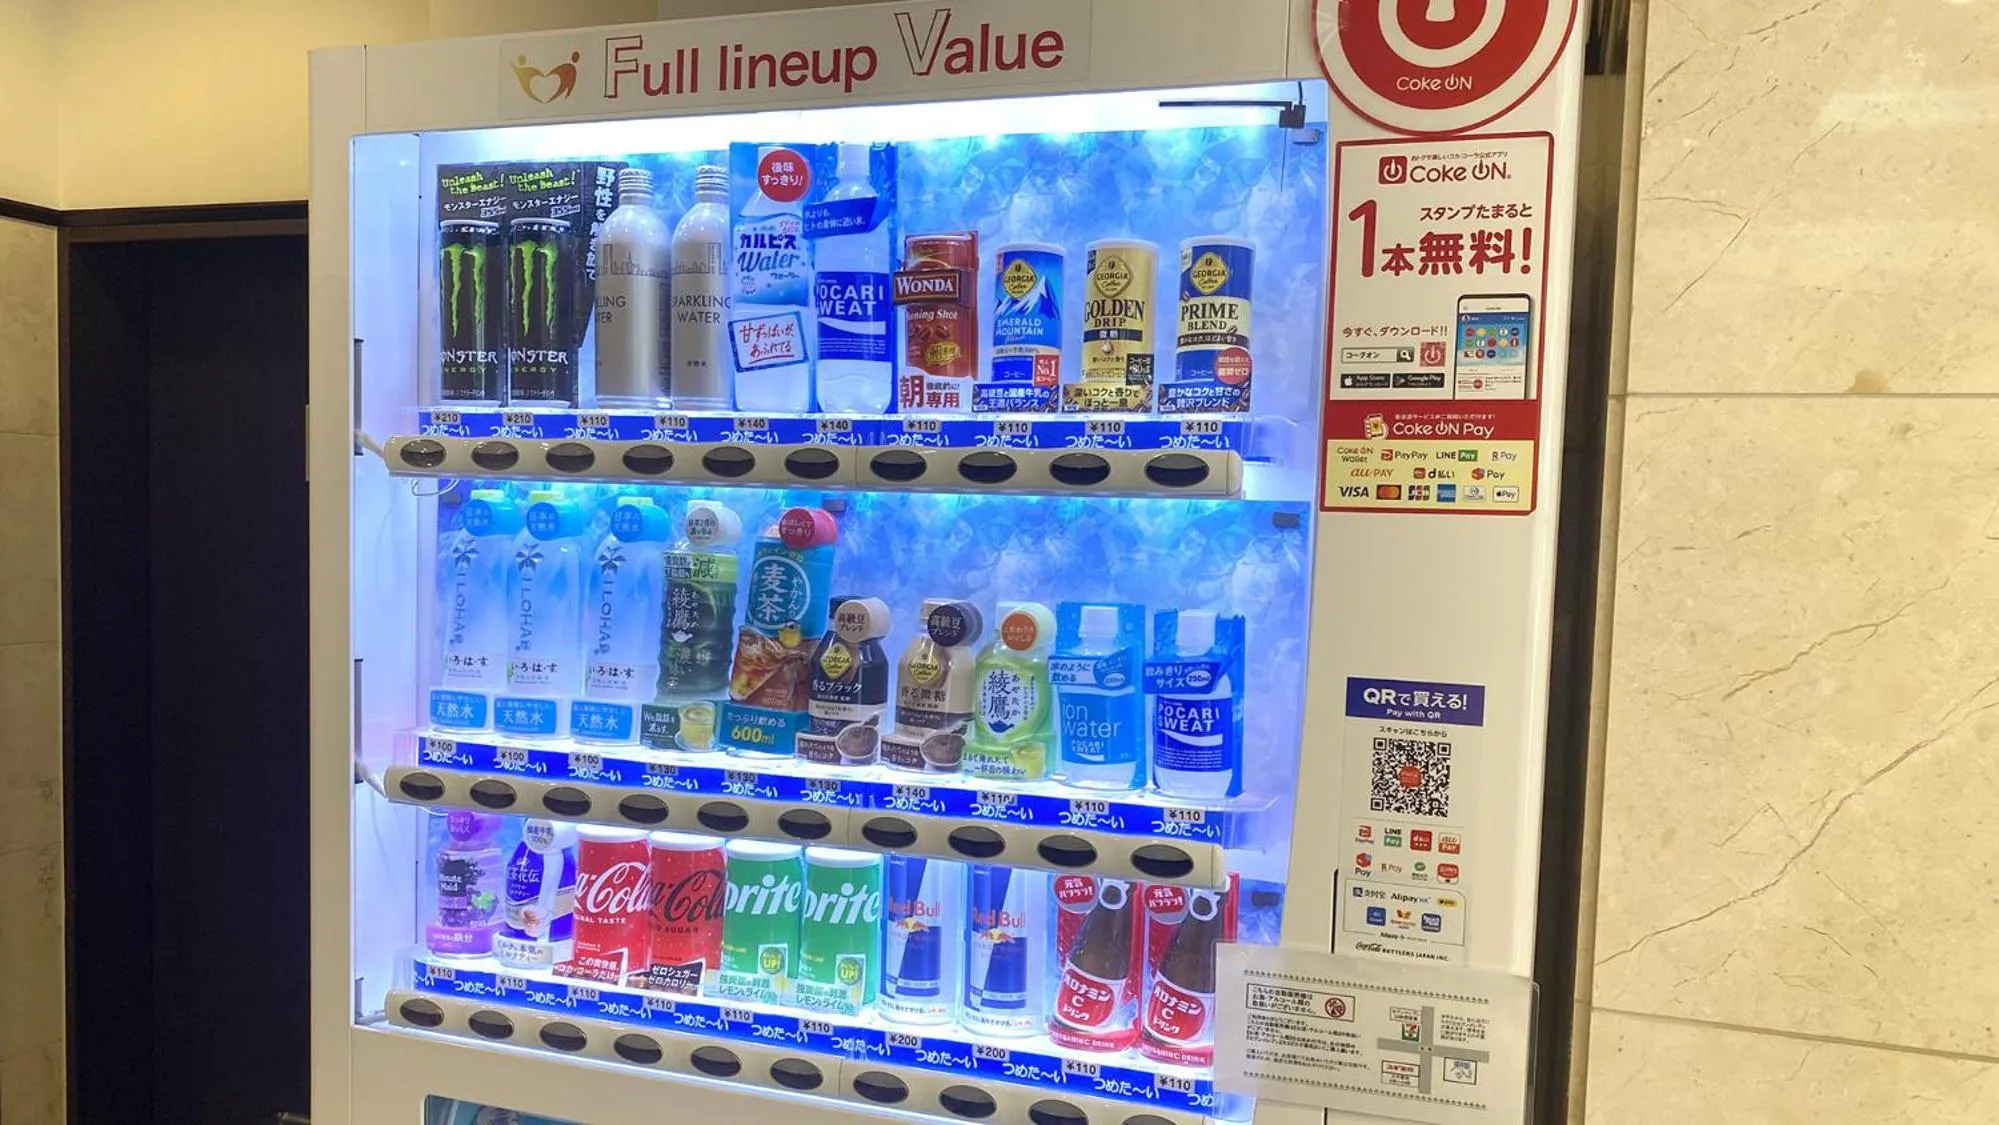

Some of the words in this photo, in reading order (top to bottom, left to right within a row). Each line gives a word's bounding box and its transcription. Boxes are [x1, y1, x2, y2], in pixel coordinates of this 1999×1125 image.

[602, 34, 700, 98] Full
[718, 44, 878, 94] lineup
[894, 8, 1066, 76] Value
[1396, 76, 1442, 92] Coke
[770, 162, 794, 174] 後味
[1410, 164, 1467, 183] Coke
[441, 171, 484, 188] Unleash
[509, 168, 554, 184] Unleash
[450, 186, 468, 195] the
[518, 182, 538, 192] the
[444, 196, 507, 212] モンスターエナジー
[512, 194, 578, 210] モンスターエナジー
[1420, 203, 1533, 221] スタンプたまると
[740, 233, 797, 250] カルピス
[737, 250, 800, 273] Water
[1096, 272, 1128, 281] GEORGIA
[1192, 269, 1226, 278] GEORGIA
[896, 276, 954, 296] WONDA
[1084, 299, 1145, 322] GOLDEN
[1180, 302, 1239, 322] PRIME
[676, 312, 720, 324] WATER
[1094, 318, 1126, 328] DRIP
[1187, 320, 1227, 331] BLEND
[900, 375, 924, 409] 朝
[1073, 387, 1139, 398] 深いコクと香りで
[1168, 386, 1240, 398] 豊かなコクと甘さの
[925, 392, 960, 408] 専用
[433, 414, 458, 423] ¥210
[506, 414, 530, 424] ¥210
[580, 416, 607, 426] ¥110
[658, 416, 686, 427] ¥110
[738, 418, 766, 428] ¥140
[820, 419, 849, 430] ¥140
[907, 420, 936, 430] ¥110
[998, 422, 1028, 432] ¥110
[1090, 422, 1121, 432] ¥110
[1185, 422, 1218, 432] ¥110
[1393, 422, 1433, 436] Coke
[1462, 422, 1494, 440] Pay
[1394, 451, 1428, 461] PayPay
[1436, 452, 1456, 460] LINE
[1500, 452, 1517, 462] Pay
[1373, 468, 1394, 478] PAY
[1486, 470, 1505, 480] Pay
[1339, 486, 1369, 498] VISA
[756, 564, 788, 622] 麦茶
[1156, 677, 1185, 688] サイズ
[988, 670, 1010, 720] 綾鷹
[1362, 687, 1468, 710] QRで買える!
[436, 703, 475, 720] 天然水
[502, 709, 544, 725] 天然水
[1062, 704, 1088, 721] ion
[1158, 704, 1220, 720] POCARI
[1386, 708, 1402, 718] Pay
[1405, 710, 1425, 718] with
[1427, 711, 1441, 719] QR
[577, 712, 619, 730] 天然水
[1158, 716, 1214, 732] SWEAT
[731, 726, 775, 744] 600ml
[1378, 725, 1448, 738] スキャンはこちらから
[429, 740, 453, 752] ¥100
[500, 752, 524, 762] ¥100
[574, 754, 598, 765] ¥100
[895, 786, 926, 798] ¥140
[1074, 802, 1105, 813] ¥110
[1169, 810, 1200, 821] ¥110
[1064, 879, 1083, 889] 元気
[1153, 887, 1173, 899] 元気
[913, 899, 940, 917] Bull
[998, 911, 1026, 929] Bull
[1416, 952, 1435, 960] JAPAN
[430, 967, 452, 978] ¥110
[652, 965, 698, 978] ゼロシュガー
[500, 976, 523, 988] ¥110
[572, 987, 596, 998] ¥110
[647, 1000, 672, 1010] ¥110
[1071, 994, 1084, 1008] C
[724, 1009, 750, 1020] ¥110
[1063, 1003, 1090, 1022] ドリンク
[1160, 1008, 1174, 1020] C
[803, 1020, 830, 1033] ¥110
[1153, 1018, 1181, 1034] ドリンク
[890, 1034, 918, 1047] ¥200
[976, 1046, 1006, 1058] ¥200
[1066, 1060, 1096, 1075] ¥110
[1159, 1078, 1191, 1090] ¥110
